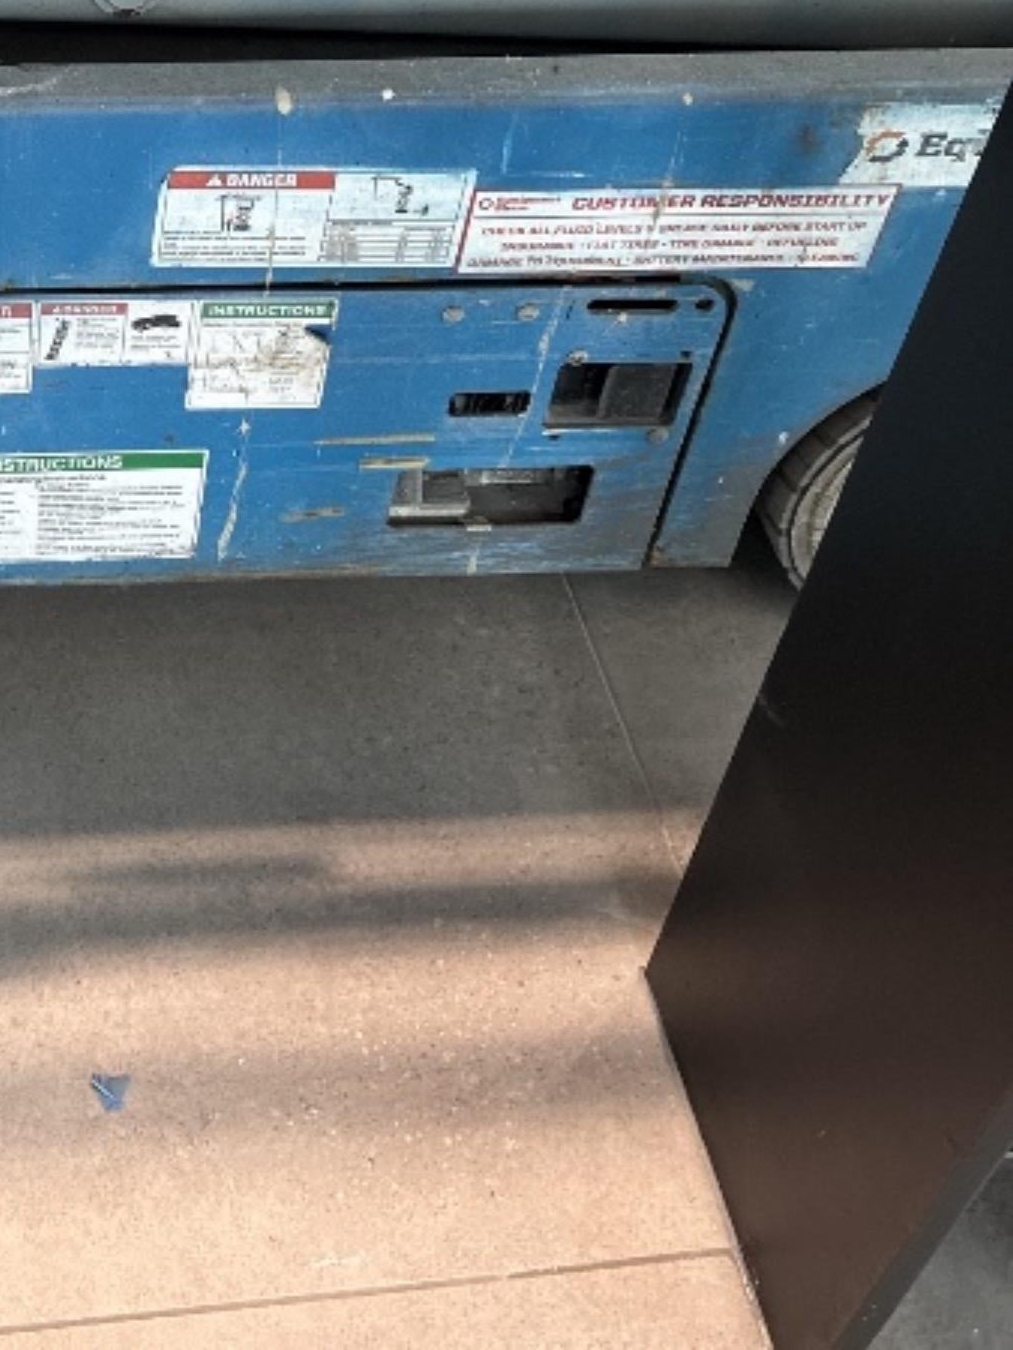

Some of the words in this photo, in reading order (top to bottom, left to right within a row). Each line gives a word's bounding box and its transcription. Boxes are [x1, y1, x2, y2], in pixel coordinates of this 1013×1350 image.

[226, 173, 298, 187] DANGER
[572, 196, 696, 210] CUSTOMER
[700, 193, 889, 208] RESPONSIBILITY
